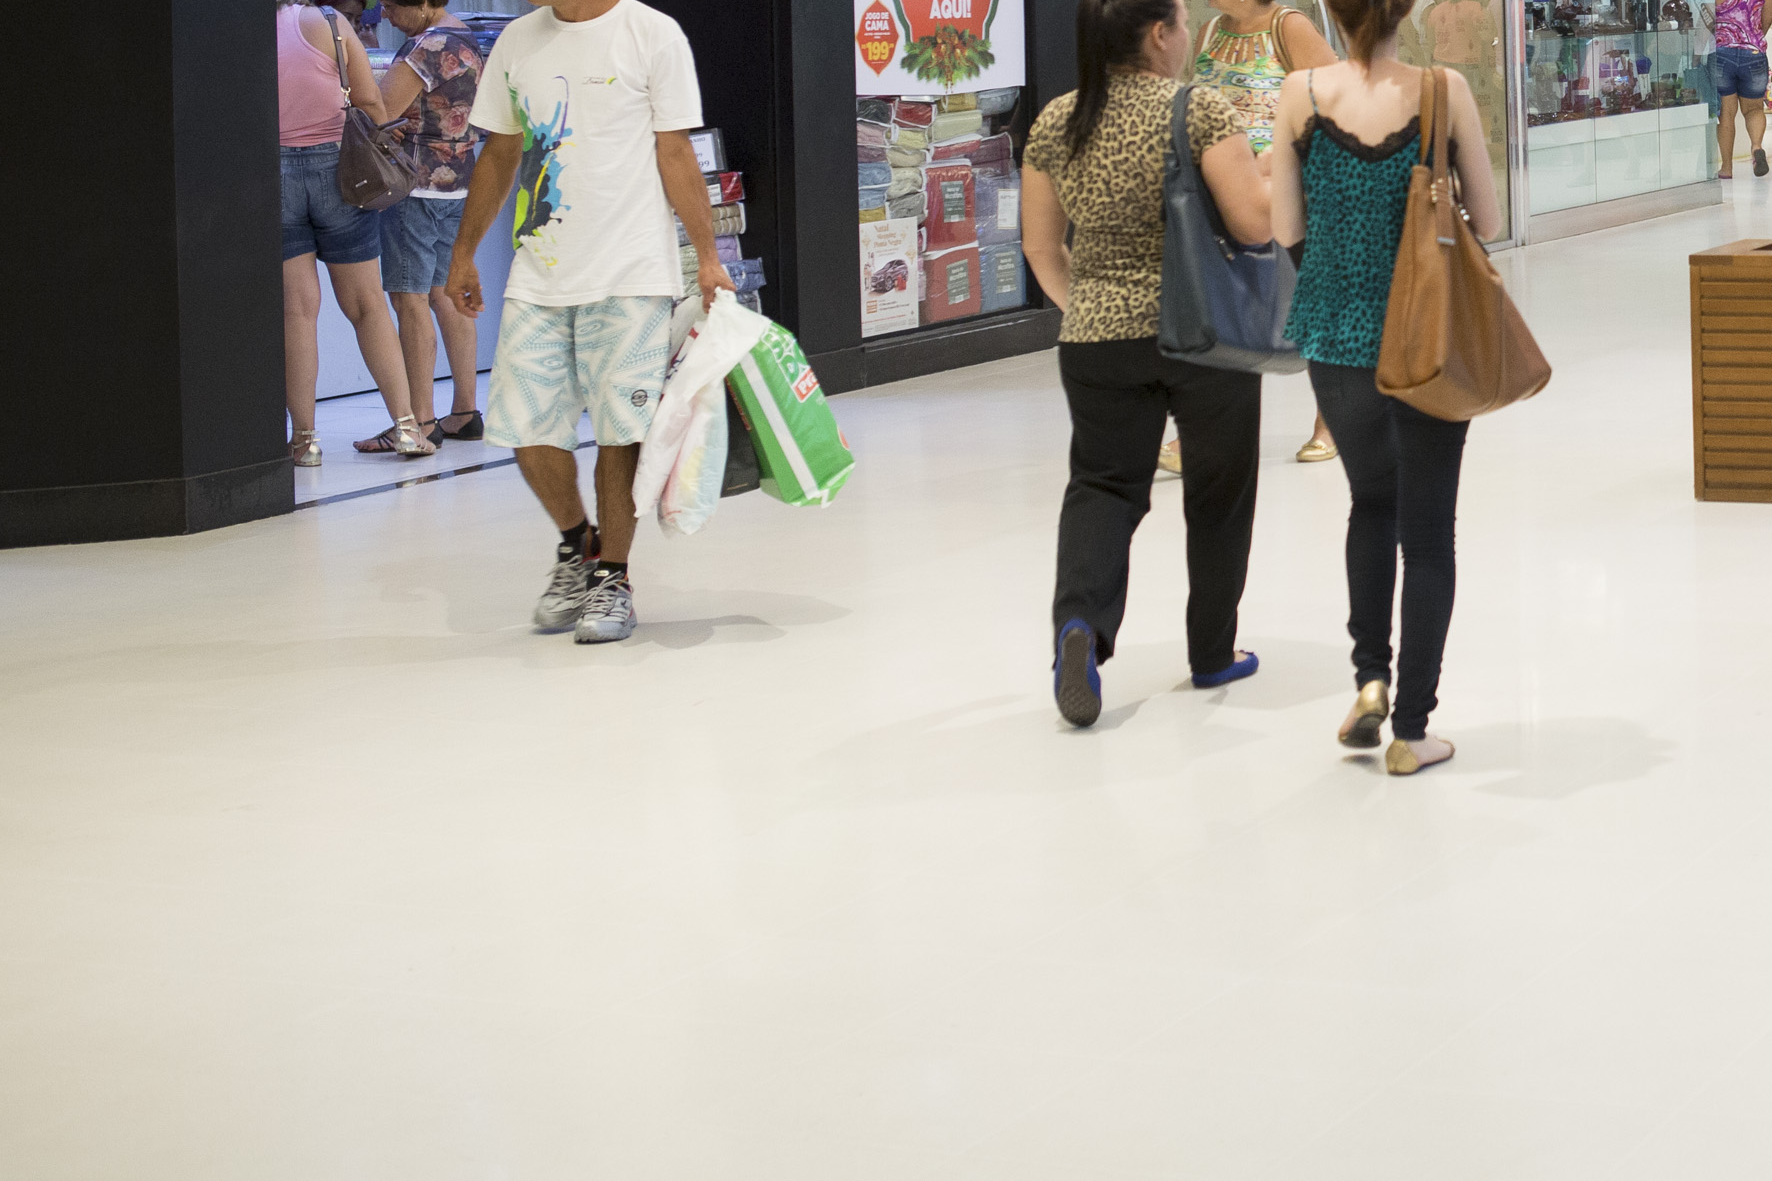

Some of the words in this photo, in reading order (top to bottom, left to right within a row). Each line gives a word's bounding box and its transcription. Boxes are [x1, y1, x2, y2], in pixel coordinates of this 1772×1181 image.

[865, 12, 880, 20] JOGO
[880, 12, 889, 20] DE
[865, 20, 890, 31] CAMA
